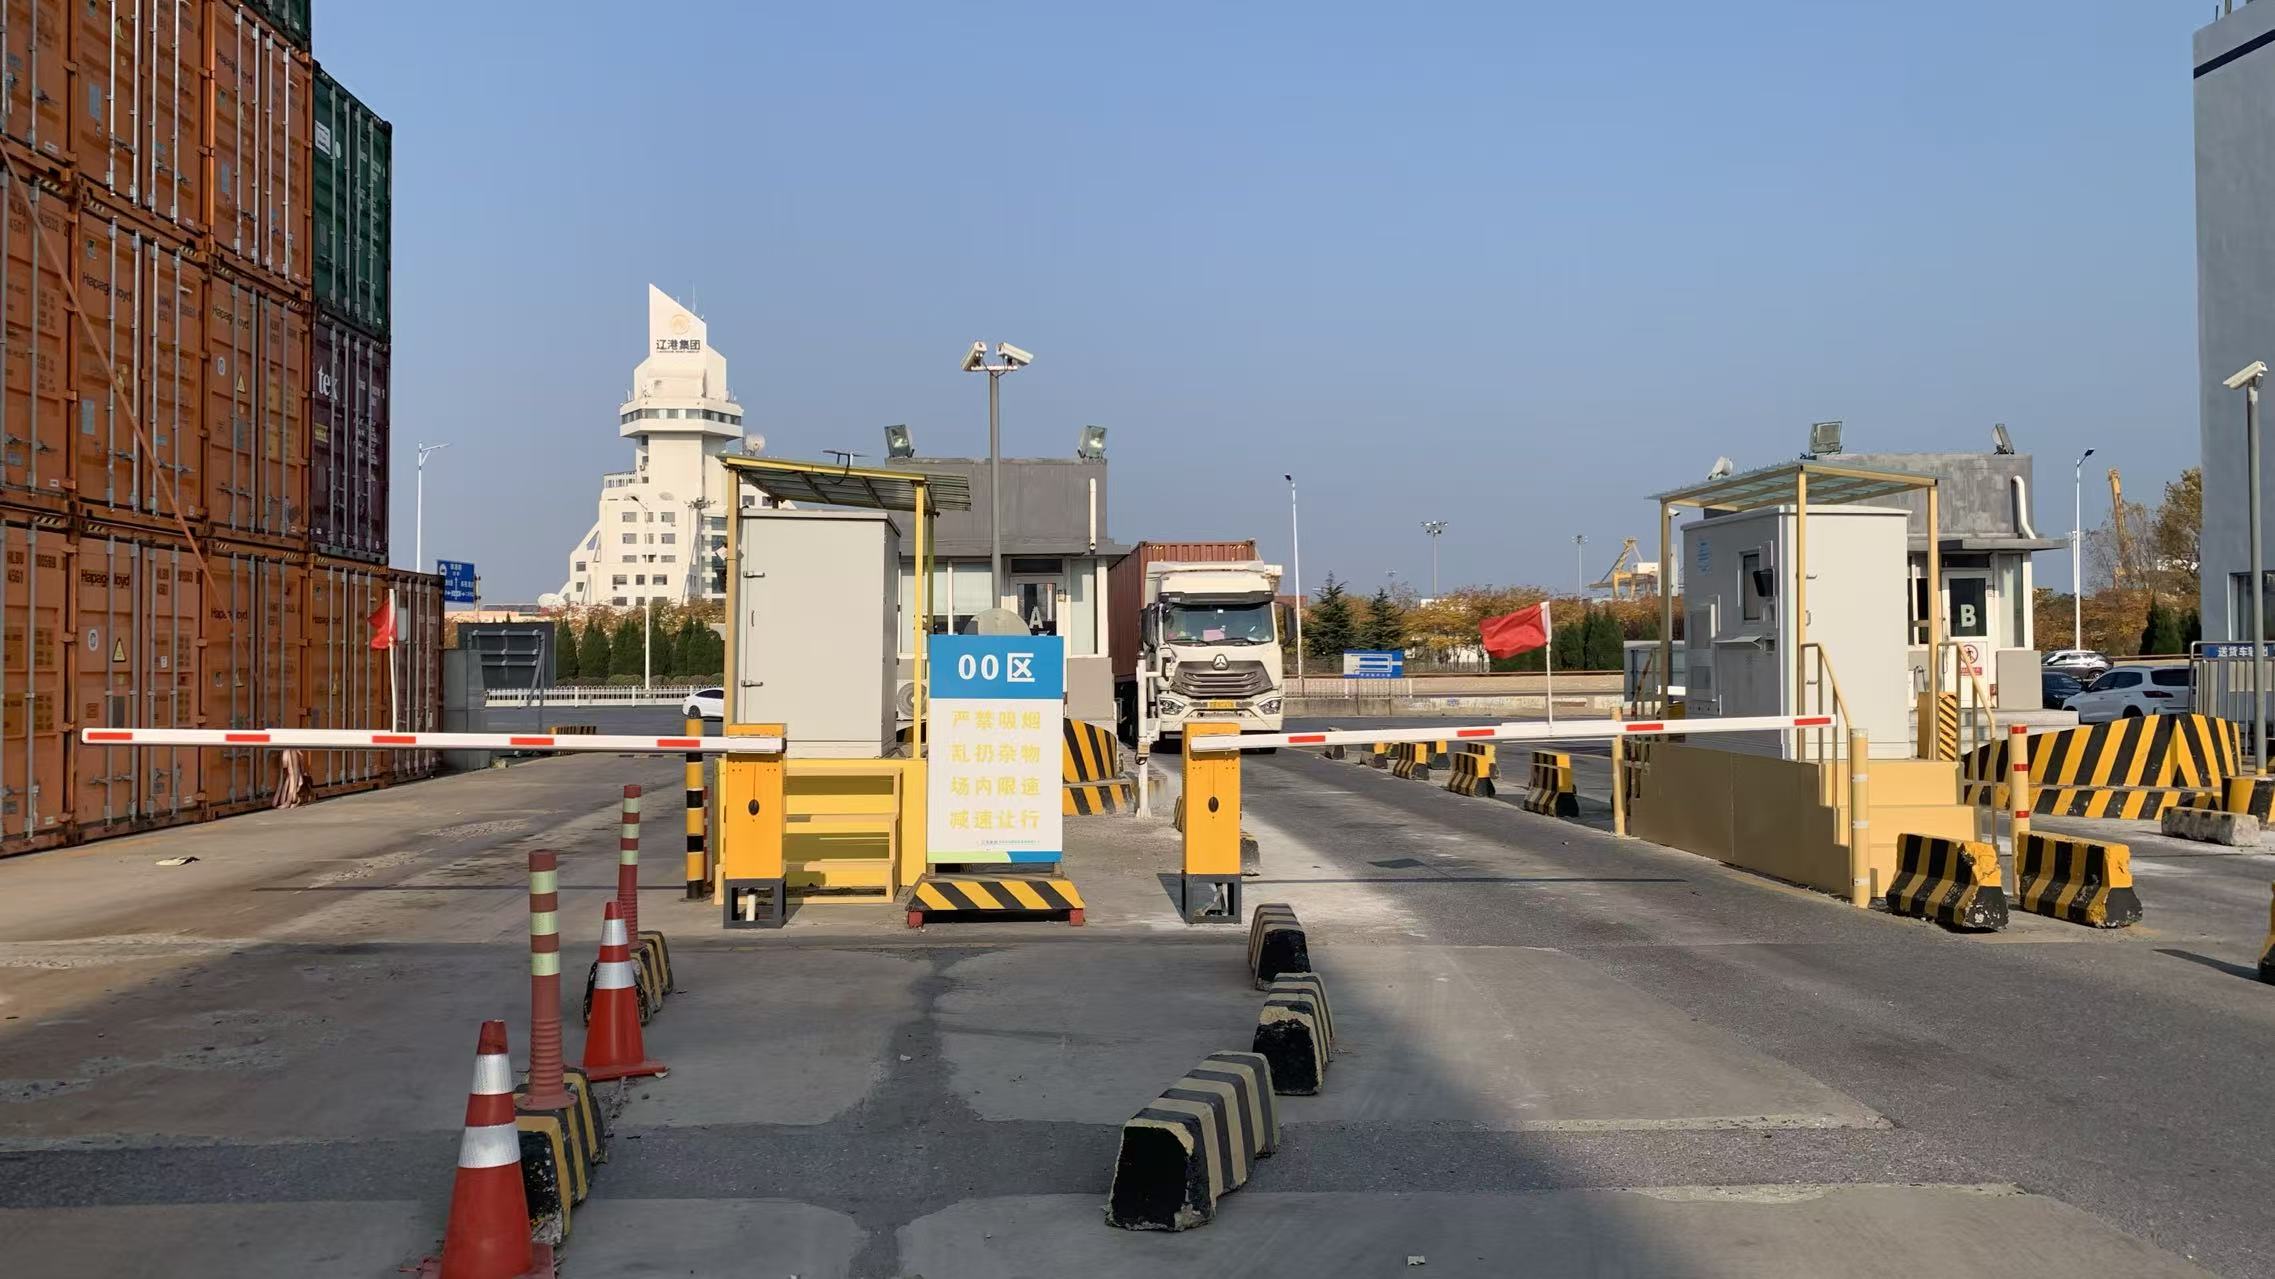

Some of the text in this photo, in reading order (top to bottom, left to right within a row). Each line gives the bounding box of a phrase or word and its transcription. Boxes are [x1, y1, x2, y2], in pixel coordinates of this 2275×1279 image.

[656, 339, 701, 351] 辽港集团
[1029, 606, 1044, 629] A
[1960, 603, 1976, 628] B
[958, 652, 1035, 683] 00区
[951, 709, 1041, 730] 严禁吸烟
[951, 743, 1041, 763] 乱扔杂物
[950, 776, 1041, 796] 场内限速
[949, 809, 1041, 830] 减速让行
